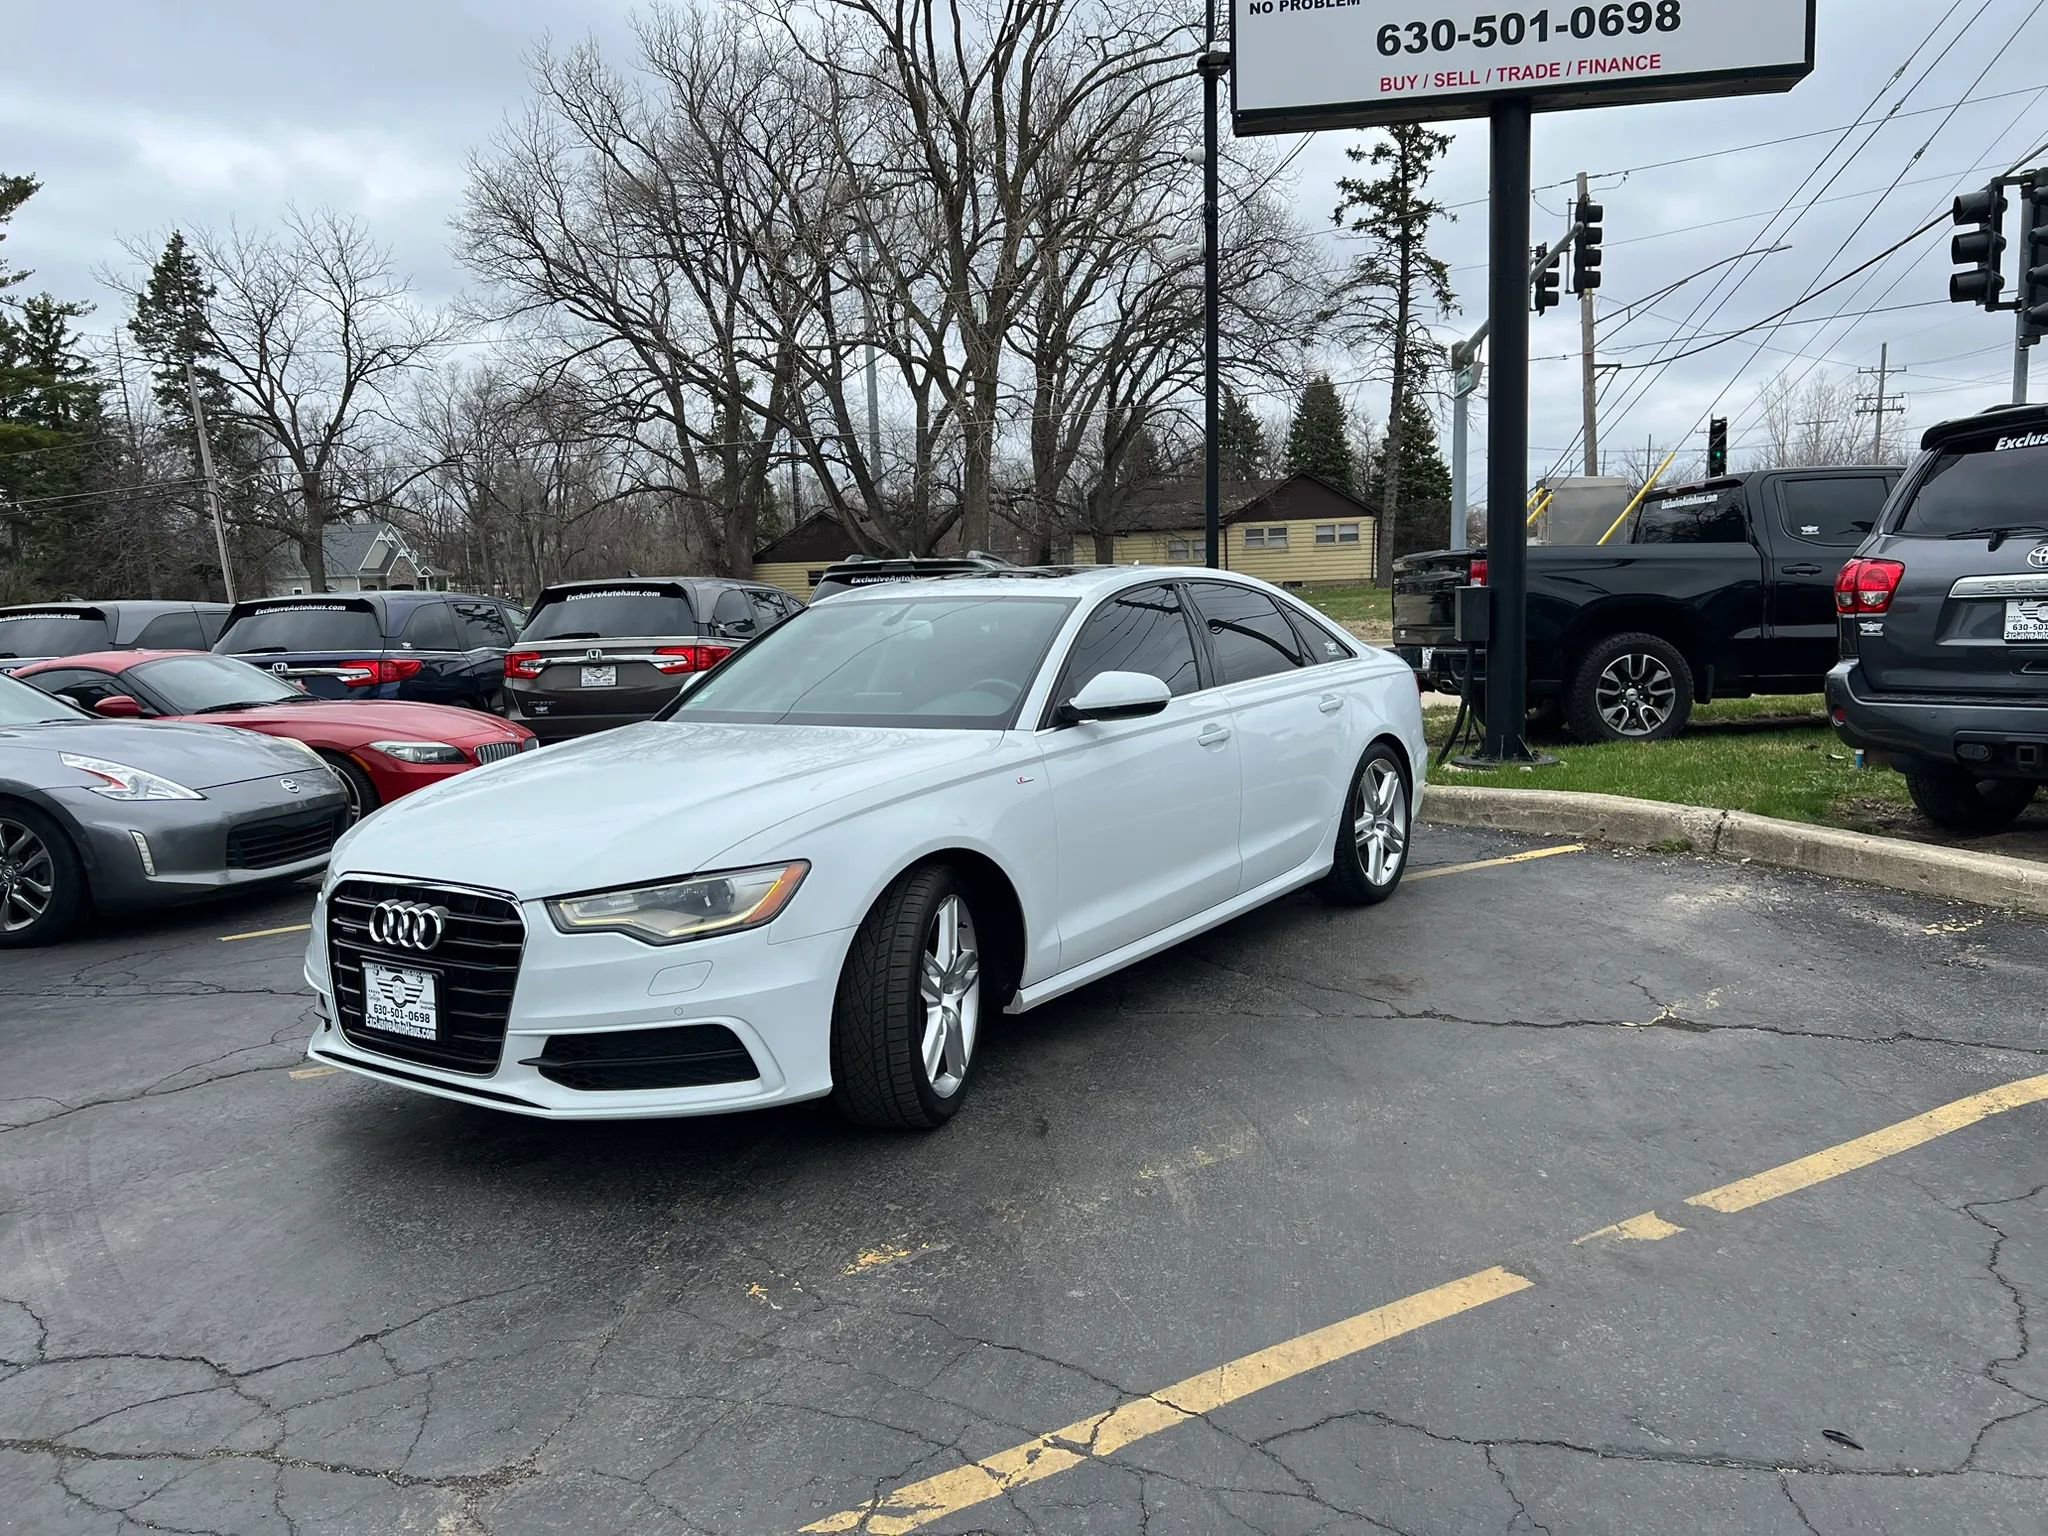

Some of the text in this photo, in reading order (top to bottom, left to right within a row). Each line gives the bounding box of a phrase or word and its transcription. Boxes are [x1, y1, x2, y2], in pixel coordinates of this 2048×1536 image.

[1249, 1, 1274, 15] NO
[1376, 0, 1681, 56] 630-501-0698
[1380, 74, 1418, 92] BUY
[1434, 70, 1481, 88] SELL
[1496, 62, 1561, 82] TRADE
[1577, 54, 1661, 75] FINANCE
[1995, 432, 2048, 451] Exclus
[566, 589, 660, 602] ExclusiveAutohaus.com
[254, 604, 346, 616] ExclusiveAutohaus.com
[373, 1003, 431, 1024] 630-501-0698
